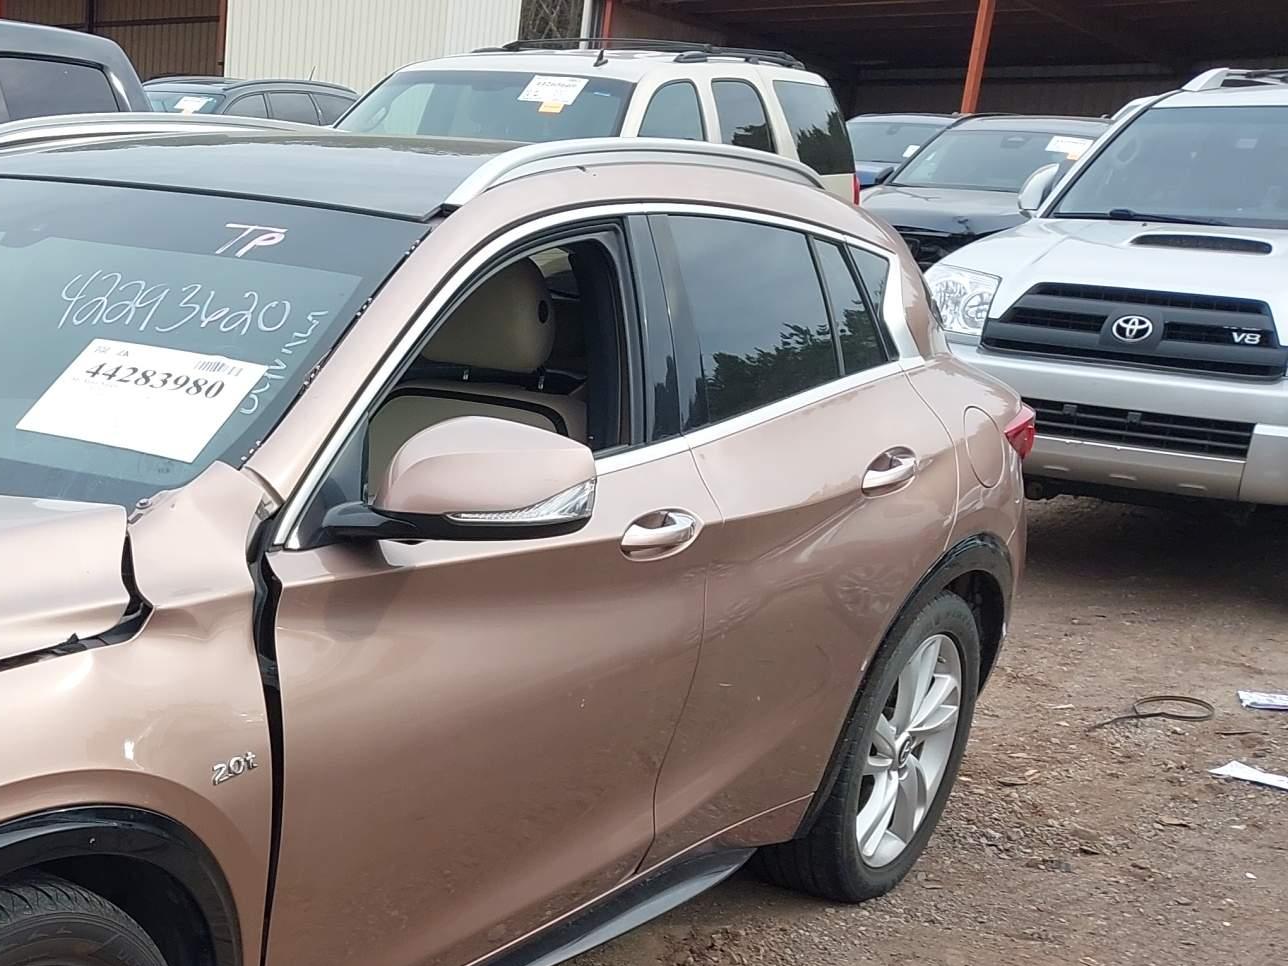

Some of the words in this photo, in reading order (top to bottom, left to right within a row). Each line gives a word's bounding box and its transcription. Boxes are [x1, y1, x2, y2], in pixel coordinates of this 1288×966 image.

[214, 223, 289, 258] TP
[58, 269, 291, 336] 42293620
[1231, 330, 1262, 345] V8
[85, 362, 226, 400] 44283980
